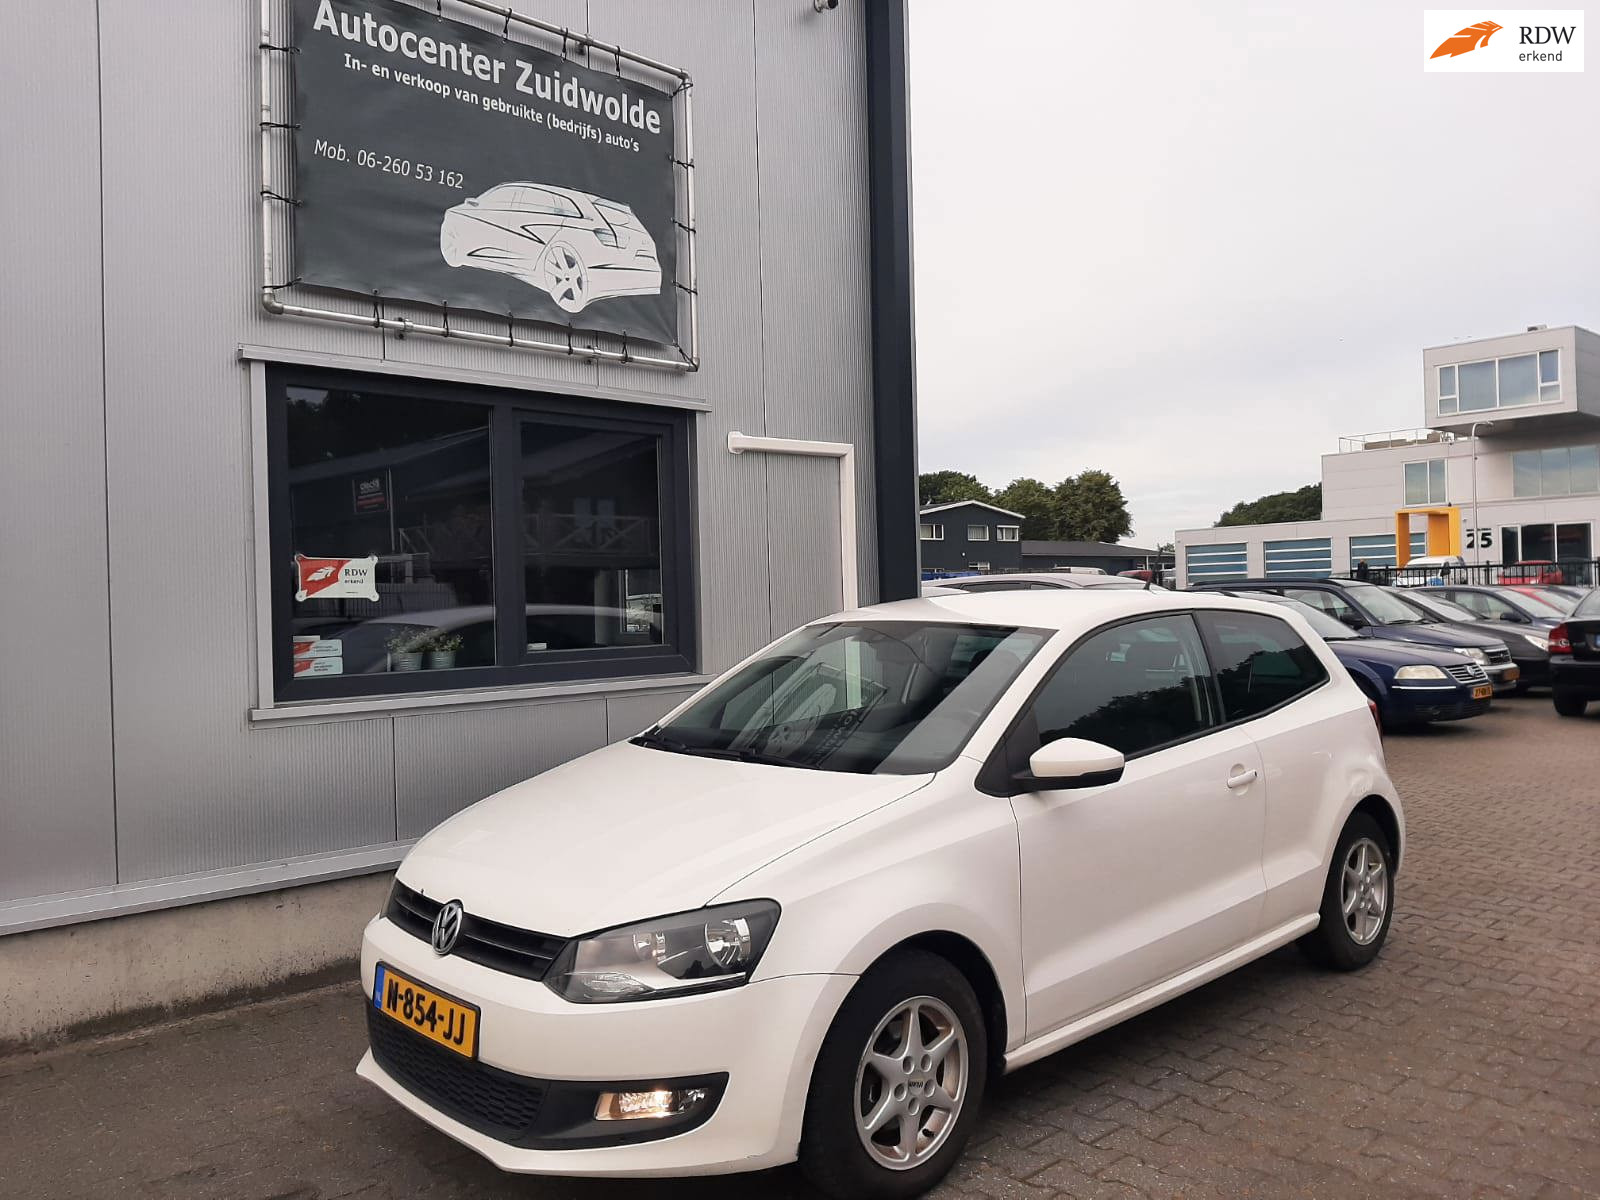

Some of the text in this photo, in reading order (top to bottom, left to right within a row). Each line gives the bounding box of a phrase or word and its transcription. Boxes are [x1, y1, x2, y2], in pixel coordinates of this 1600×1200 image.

[313, 0, 661, 134] Autocenter Zuidwolde
[344, 53, 640, 153] In- en verkoop van gebruikte (bedrijfs) auto's
[314, 139, 464, 190] Mob. 06-260 53 162
[1466, 532, 1493, 549] 25
[344, 568, 368, 577] RDW
[386, 978, 466, 1046] N-854-JJ
